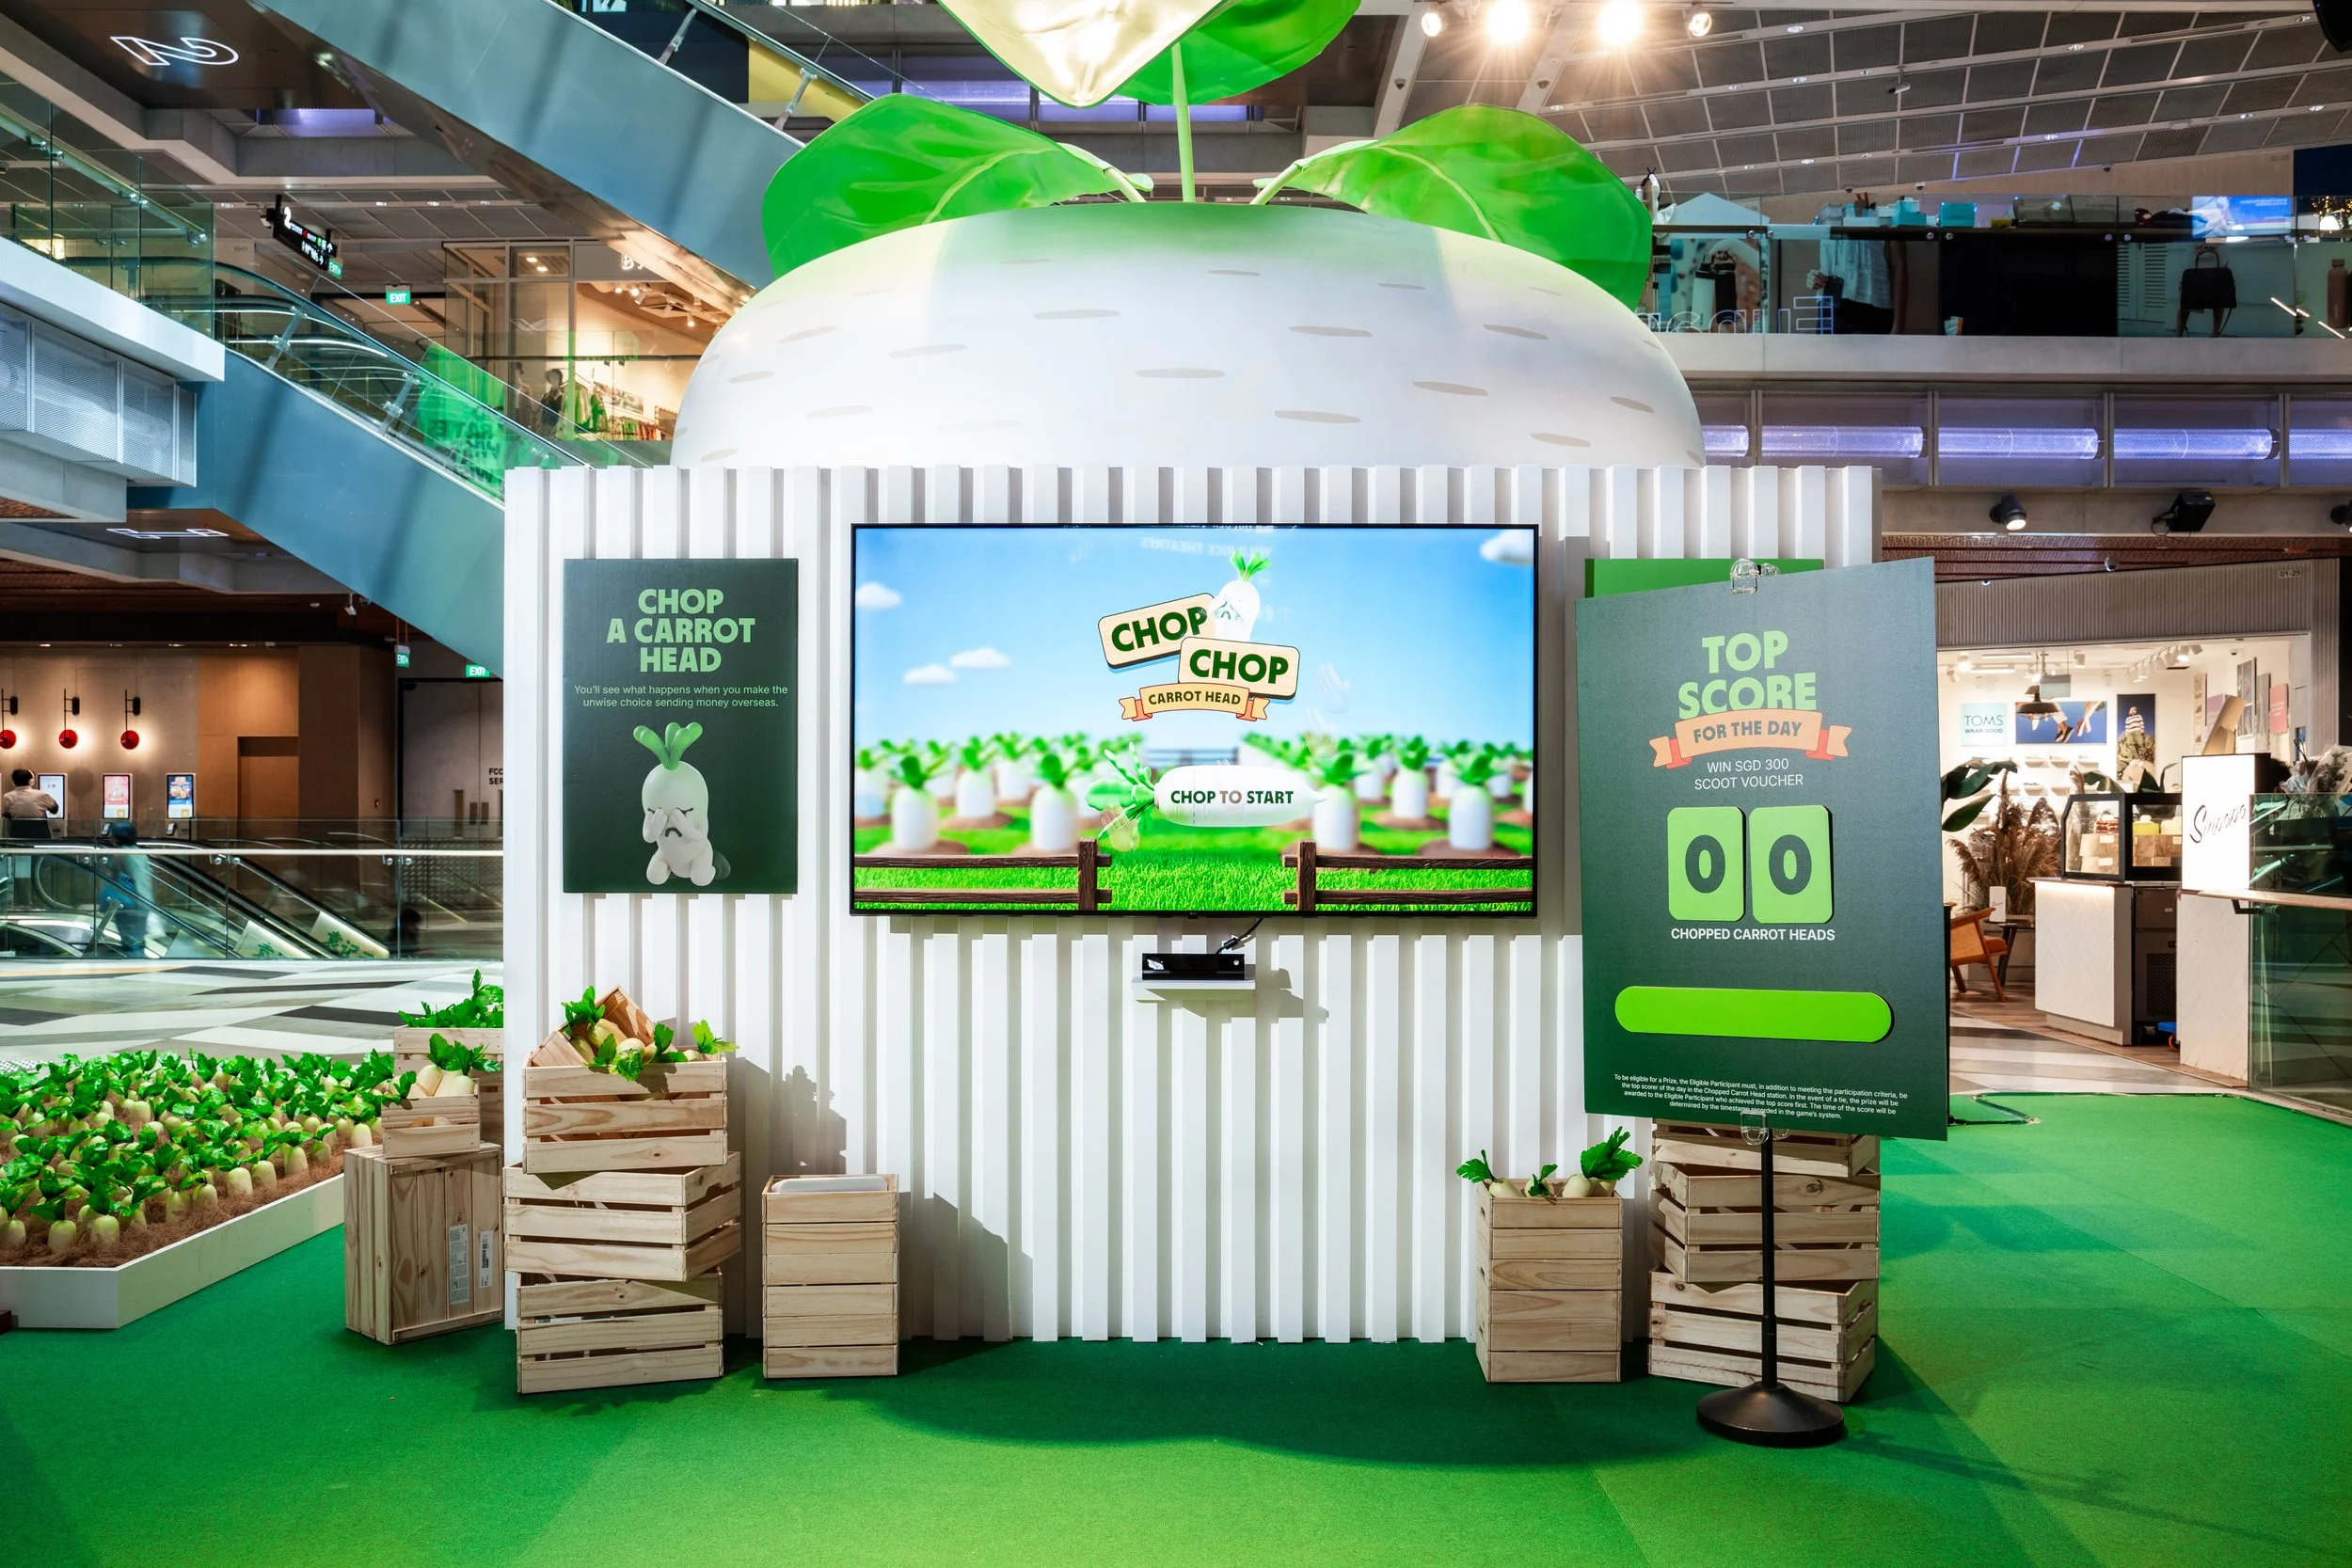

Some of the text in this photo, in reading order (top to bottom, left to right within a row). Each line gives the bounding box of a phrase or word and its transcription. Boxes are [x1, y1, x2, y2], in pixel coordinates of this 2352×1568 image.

[389, 293, 406, 303] EXIT
[638, 589, 723, 614] CHOP
[606, 618, 755, 643] A CARROT
[1111, 607, 1207, 652] CHOP
[640, 647, 722, 672] HEAD
[1702, 630, 1788, 673] TOP
[469, 666, 485, 676] EXIT
[1189, 649, 1289, 684] CHOP
[574, 685, 600, 694] You'll
[623, 685, 646, 694] what
[649, 685, 691, 697] happens
[693, 685, 720, 694] when
[723, 687, 740, 697] you
[743, 685, 770, 694] make
[772, 685, 788, 694] the
[1149, 690, 1241, 705] CARROT HEAD
[1678, 672, 1817, 720] SCORE
[583, 698, 617, 706] unwise
[620, 698, 652, 706] choice
[656, 698, 693, 708] sending
[696, 700, 728, 708] money
[1964, 715, 2003, 726] TOMS
[1693, 721, 1803, 743] FOR THE DAY
[1707, 758, 1789, 773] WIN SGD 300
[1694, 774, 1804, 790] SCOOT VOUCHER
[1170, 790, 1294, 803] CHOP TO START
[1685, 834, 1812, 895] 0 0
[1671, 928, 1836, 941] CHOPPED CARROT HEADS
[1629, 1074, 1648, 1083] eligible
[1689, 1078, 1708, 1086] Eligible
[1709, 1080, 1740, 1088] Participant
[1797, 1085, 1821, 1094] meeting
[1834, 1087, 1872, 1097] participation
[1663, 1092, 1683, 1101] Eligible
[1684, 1094, 1714, 1102] Participant
[1703, 1087, 1729, 1096] Chopped
[1860, 1098, 1877, 1106] prize
[1669, 1100, 1700, 1108] determined
[1818, 1112, 1841, 1120] system.
